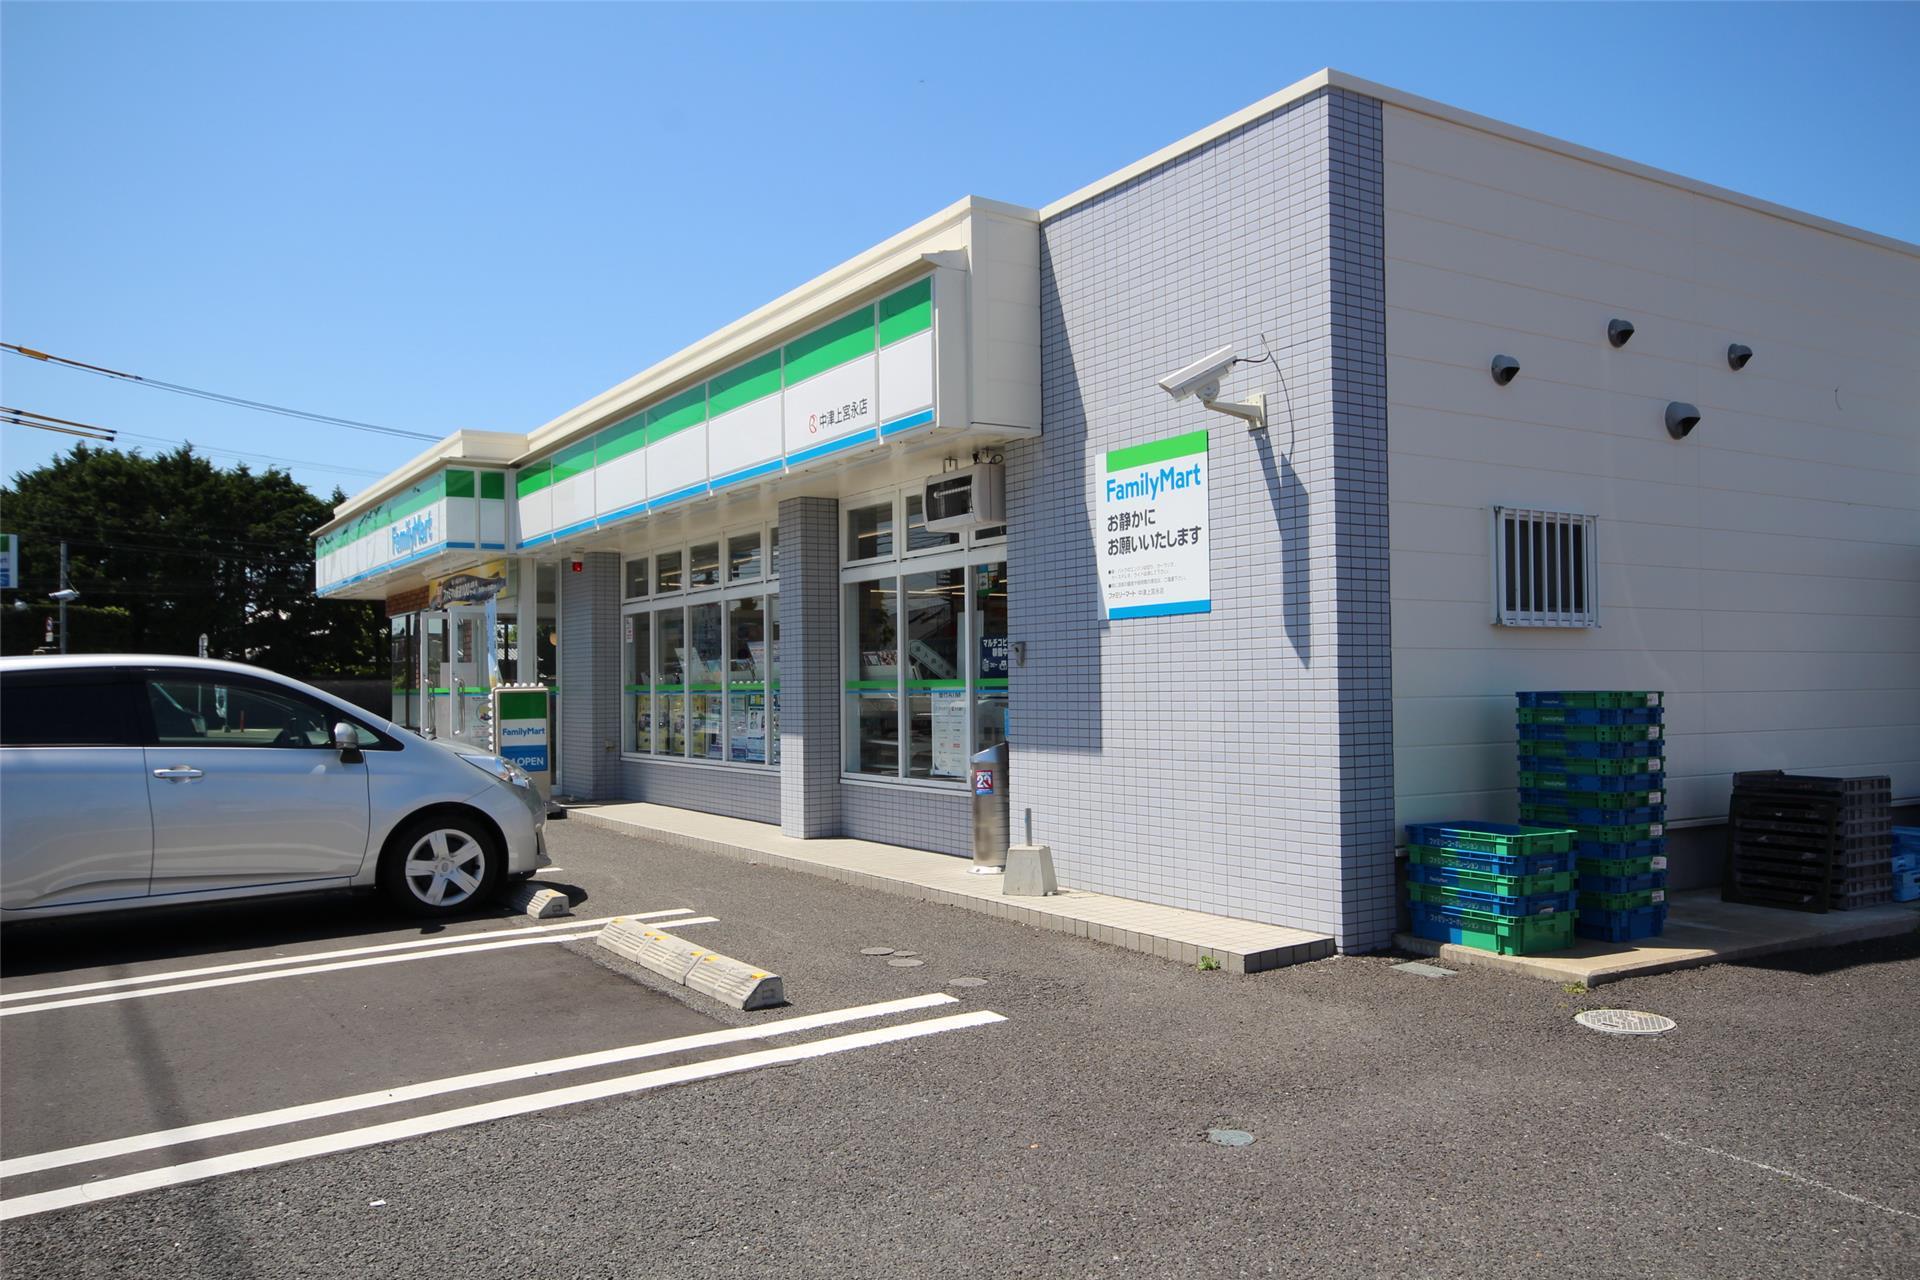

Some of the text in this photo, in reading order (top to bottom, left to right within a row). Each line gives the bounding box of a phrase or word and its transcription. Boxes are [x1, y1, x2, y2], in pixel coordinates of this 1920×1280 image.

[819, 398, 868, 429] 中津上宮永店
[1106, 463, 1201, 503] FamilyMart
[391, 510, 434, 557] FamilyMart
[1107, 509, 1156, 532] お静かに
[1107, 525, 1202, 556] お願いいたします
[502, 727, 545, 737] FamilyMart
[517, 757, 544, 766] OPEN
